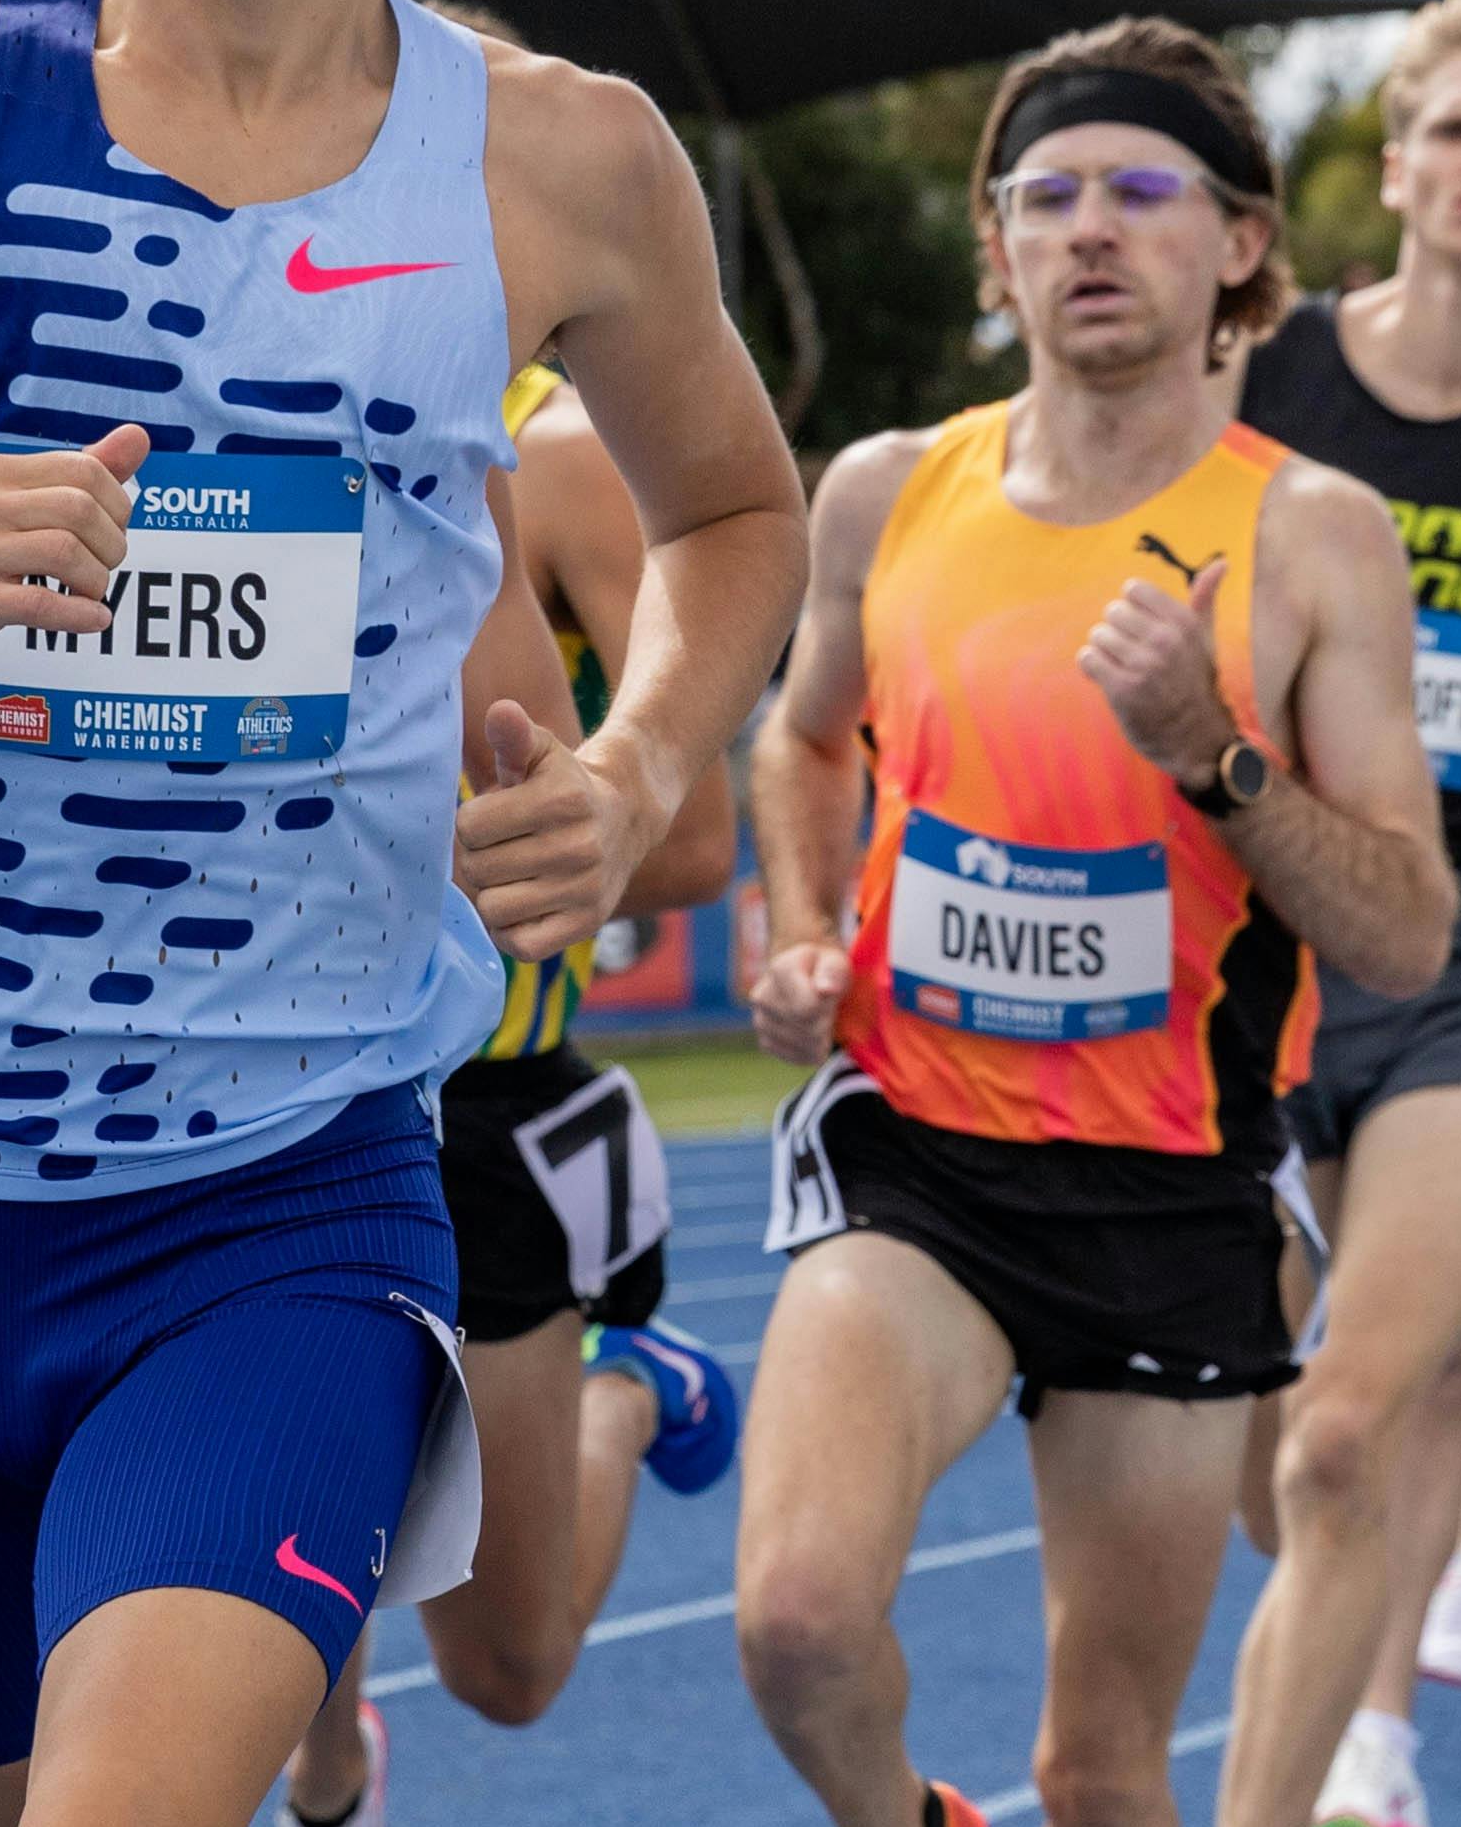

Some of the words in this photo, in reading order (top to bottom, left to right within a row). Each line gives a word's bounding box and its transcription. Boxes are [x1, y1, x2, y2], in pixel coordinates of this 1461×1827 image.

[143, 486, 251, 516] SOUTH
[143, 514, 249, 530] AUSTRALIA
[74, 699, 209, 733] CHEMIST
[237, 716, 293, 735] ATHLETICS
[74, 732, 203, 752] WAREHOUSE
[940, 899, 1106, 978] DAVIES
[538, 1087, 630, 1267] 7
